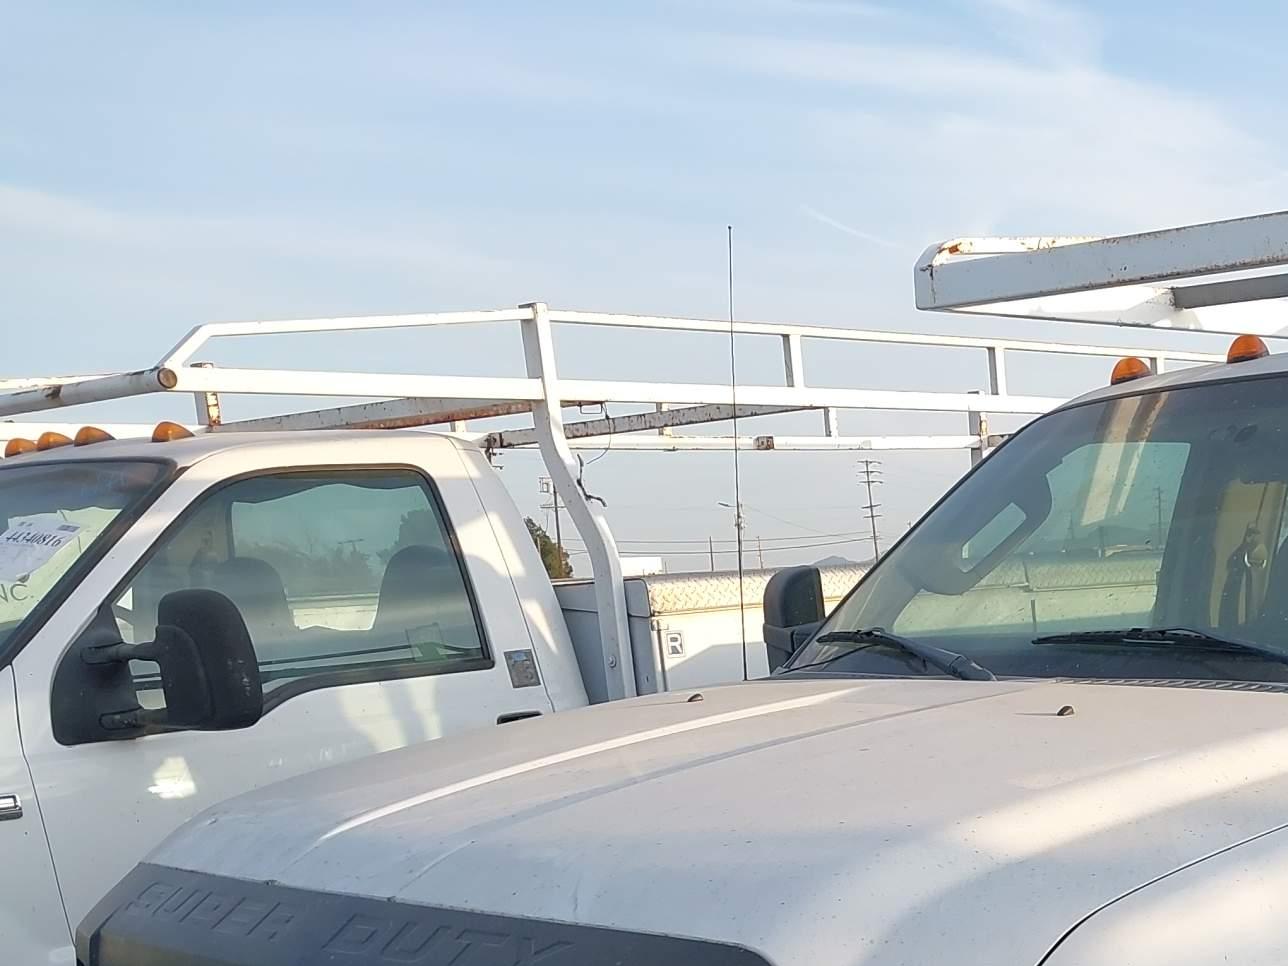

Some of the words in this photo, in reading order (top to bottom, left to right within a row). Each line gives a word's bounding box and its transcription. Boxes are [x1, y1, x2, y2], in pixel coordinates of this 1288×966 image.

[5, 531, 64, 548] 44340816
[667, 633, 683, 655] R
[126, 881, 295, 942] SUPER
